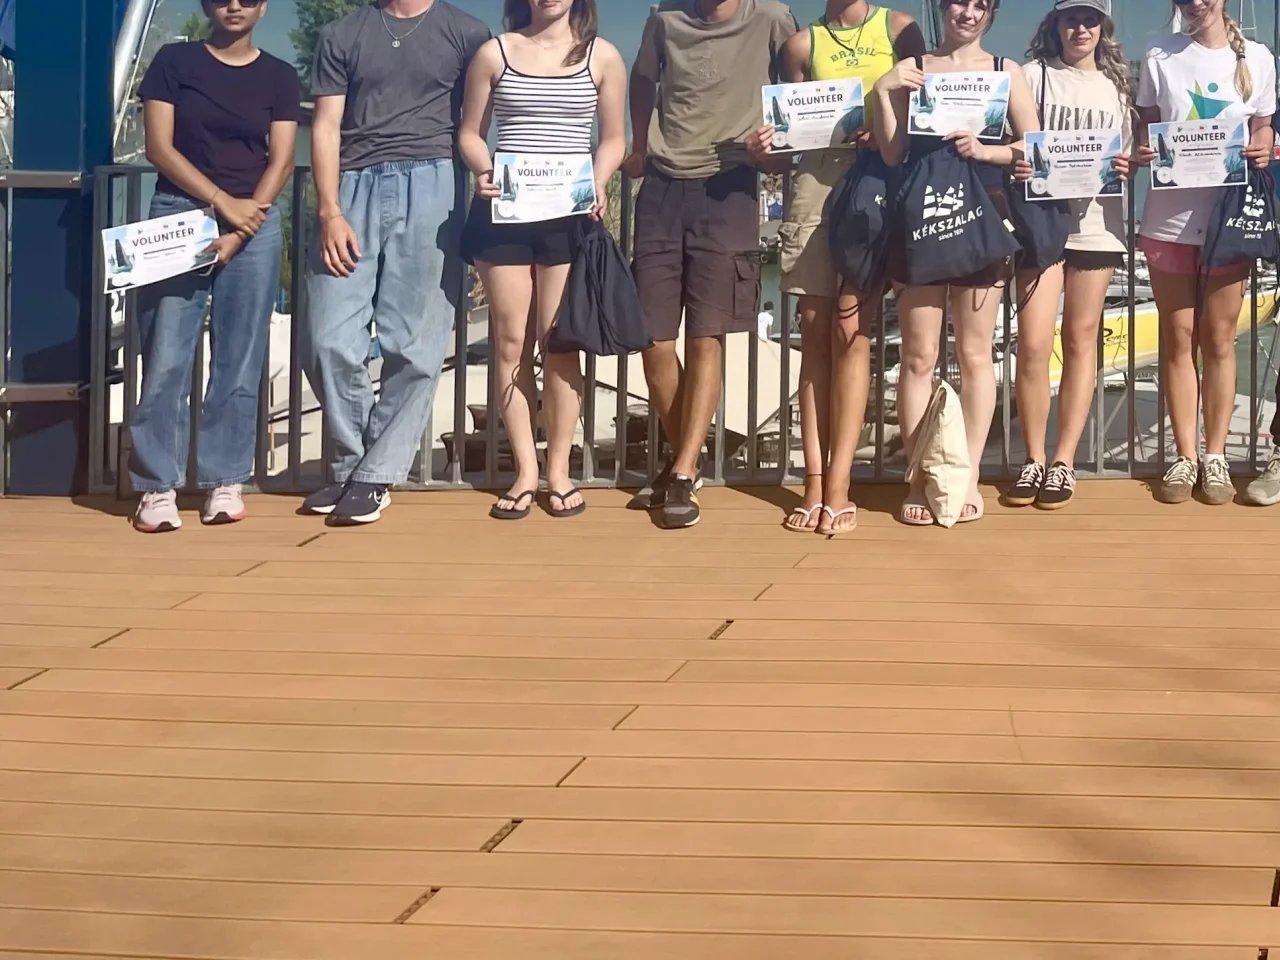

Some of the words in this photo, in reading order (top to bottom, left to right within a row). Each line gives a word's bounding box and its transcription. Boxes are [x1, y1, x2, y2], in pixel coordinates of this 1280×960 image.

[830, 47, 876, 62] BRASIL
[935, 84, 991, 92] VOLUNTEER
[787, 93, 844, 107] VOLUNTEER
[1172, 132, 1226, 143] VOLUNTEER
[1048, 143, 1103, 153] VOLUNTEER
[517, 168, 572, 177] VOLUNTEER
[912, 205, 983, 241] KÉKSZALAG
[132, 227, 195, 247] VOLUNTEER
